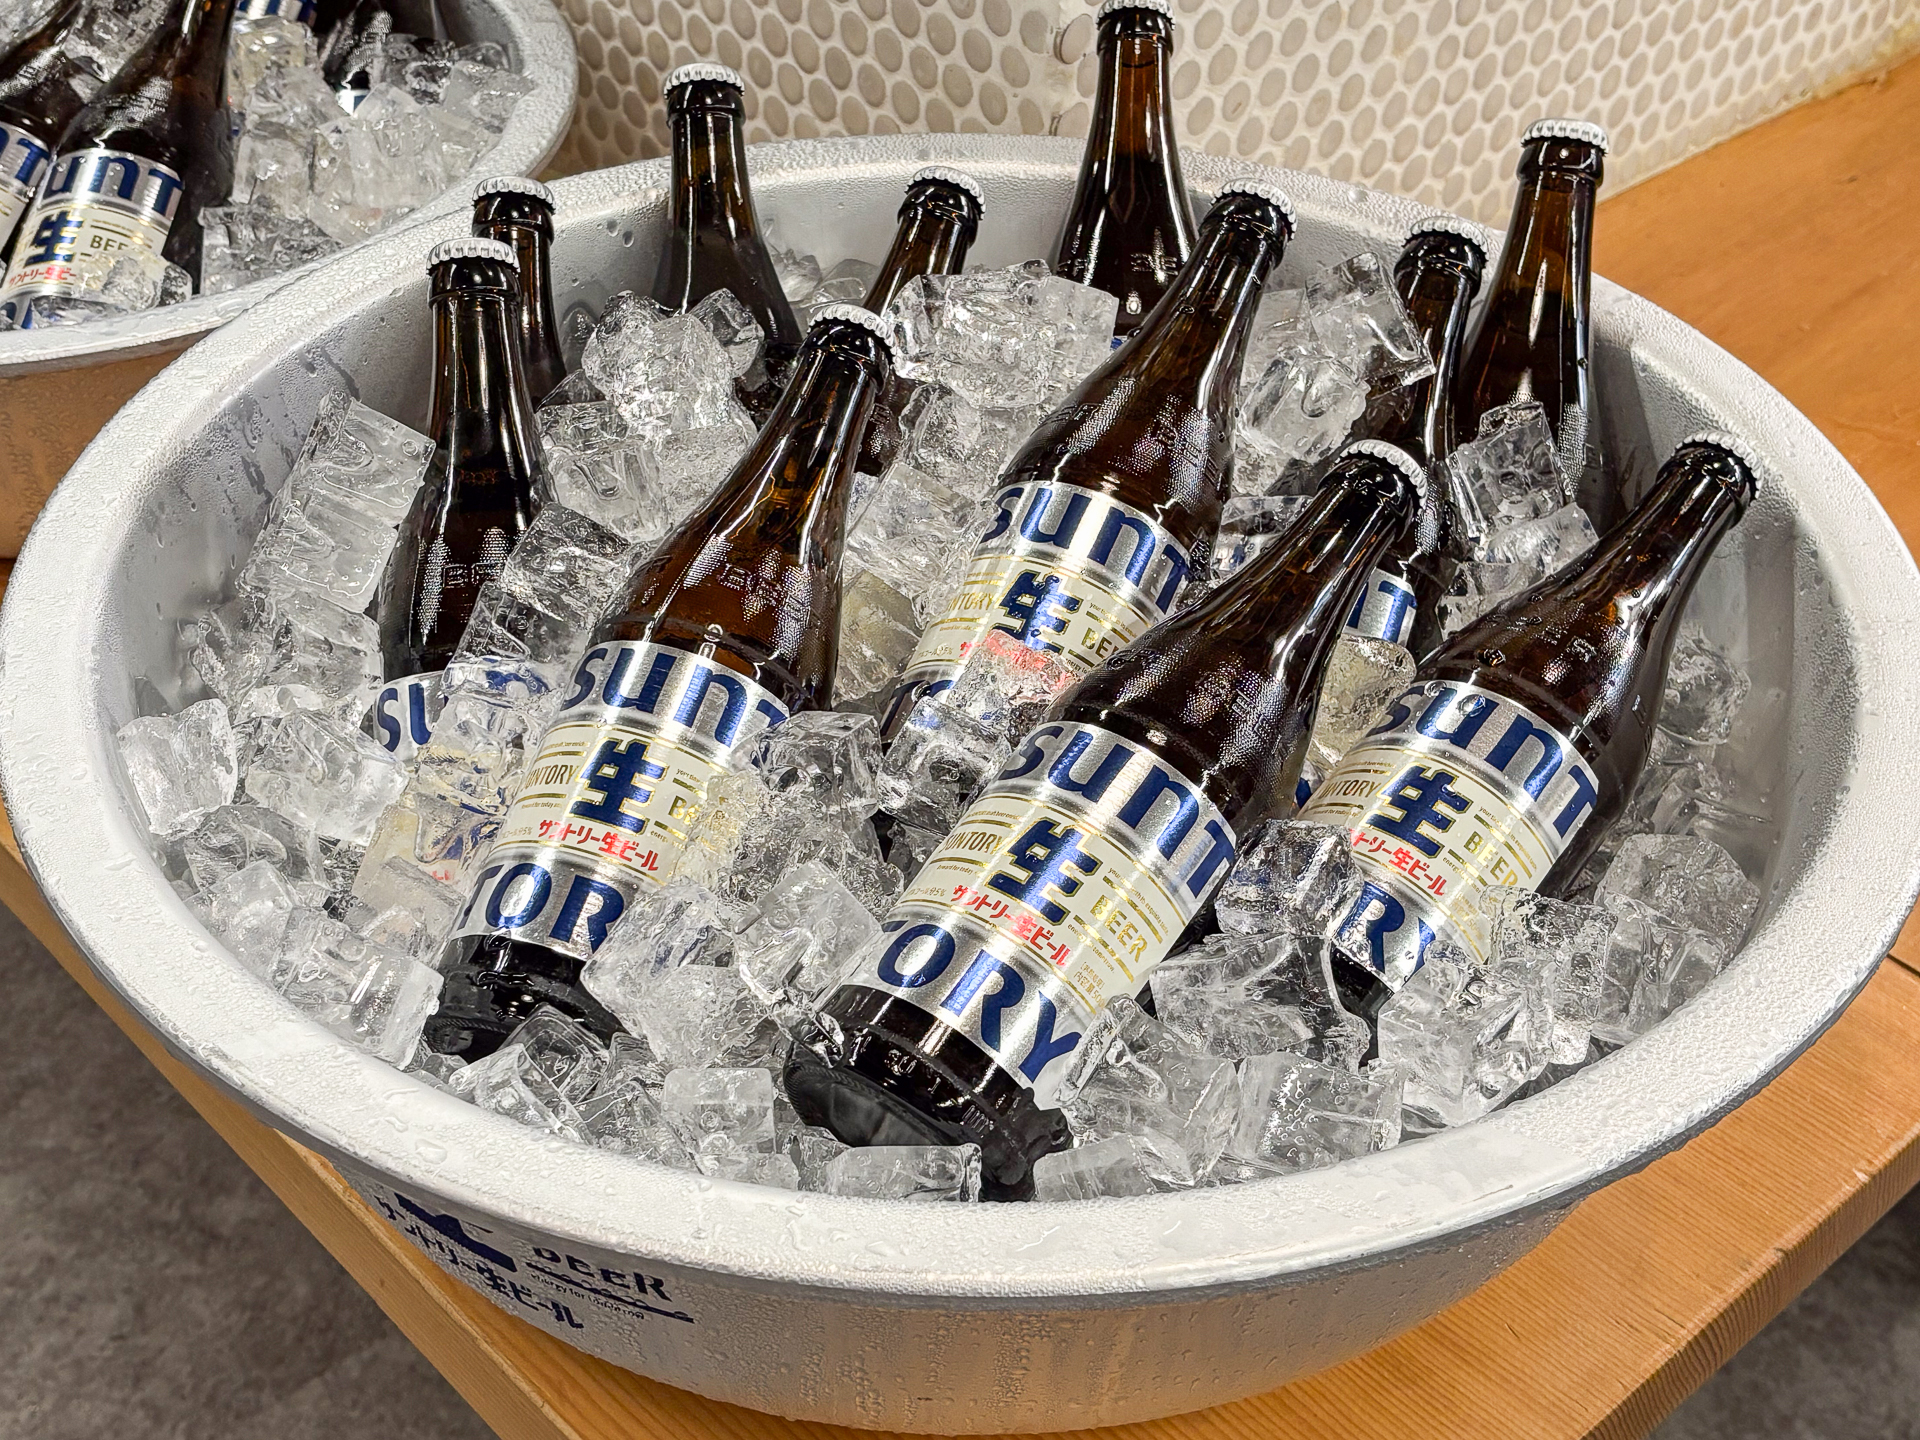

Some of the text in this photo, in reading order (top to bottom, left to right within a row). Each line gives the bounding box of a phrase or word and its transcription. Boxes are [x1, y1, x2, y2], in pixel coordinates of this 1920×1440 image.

[24, 209, 85, 267] 生
[989, 568, 1084, 653] 生
[520, 763, 579, 792] UNTORY
[565, 736, 668, 836] 生
[1316, 779, 1382, 800] UNTORY
[1363, 762, 1474, 860] 生
[538, 819, 659, 873] サントリー生ビール
[983, 816, 1104, 927] 生
[1349, 829, 1448, 897] トリー生ビール
[949, 883, 1074, 970] サントリー生ビール
[1090, 894, 1148, 963] BEER
[877, 920, 1083, 1084] ORY
